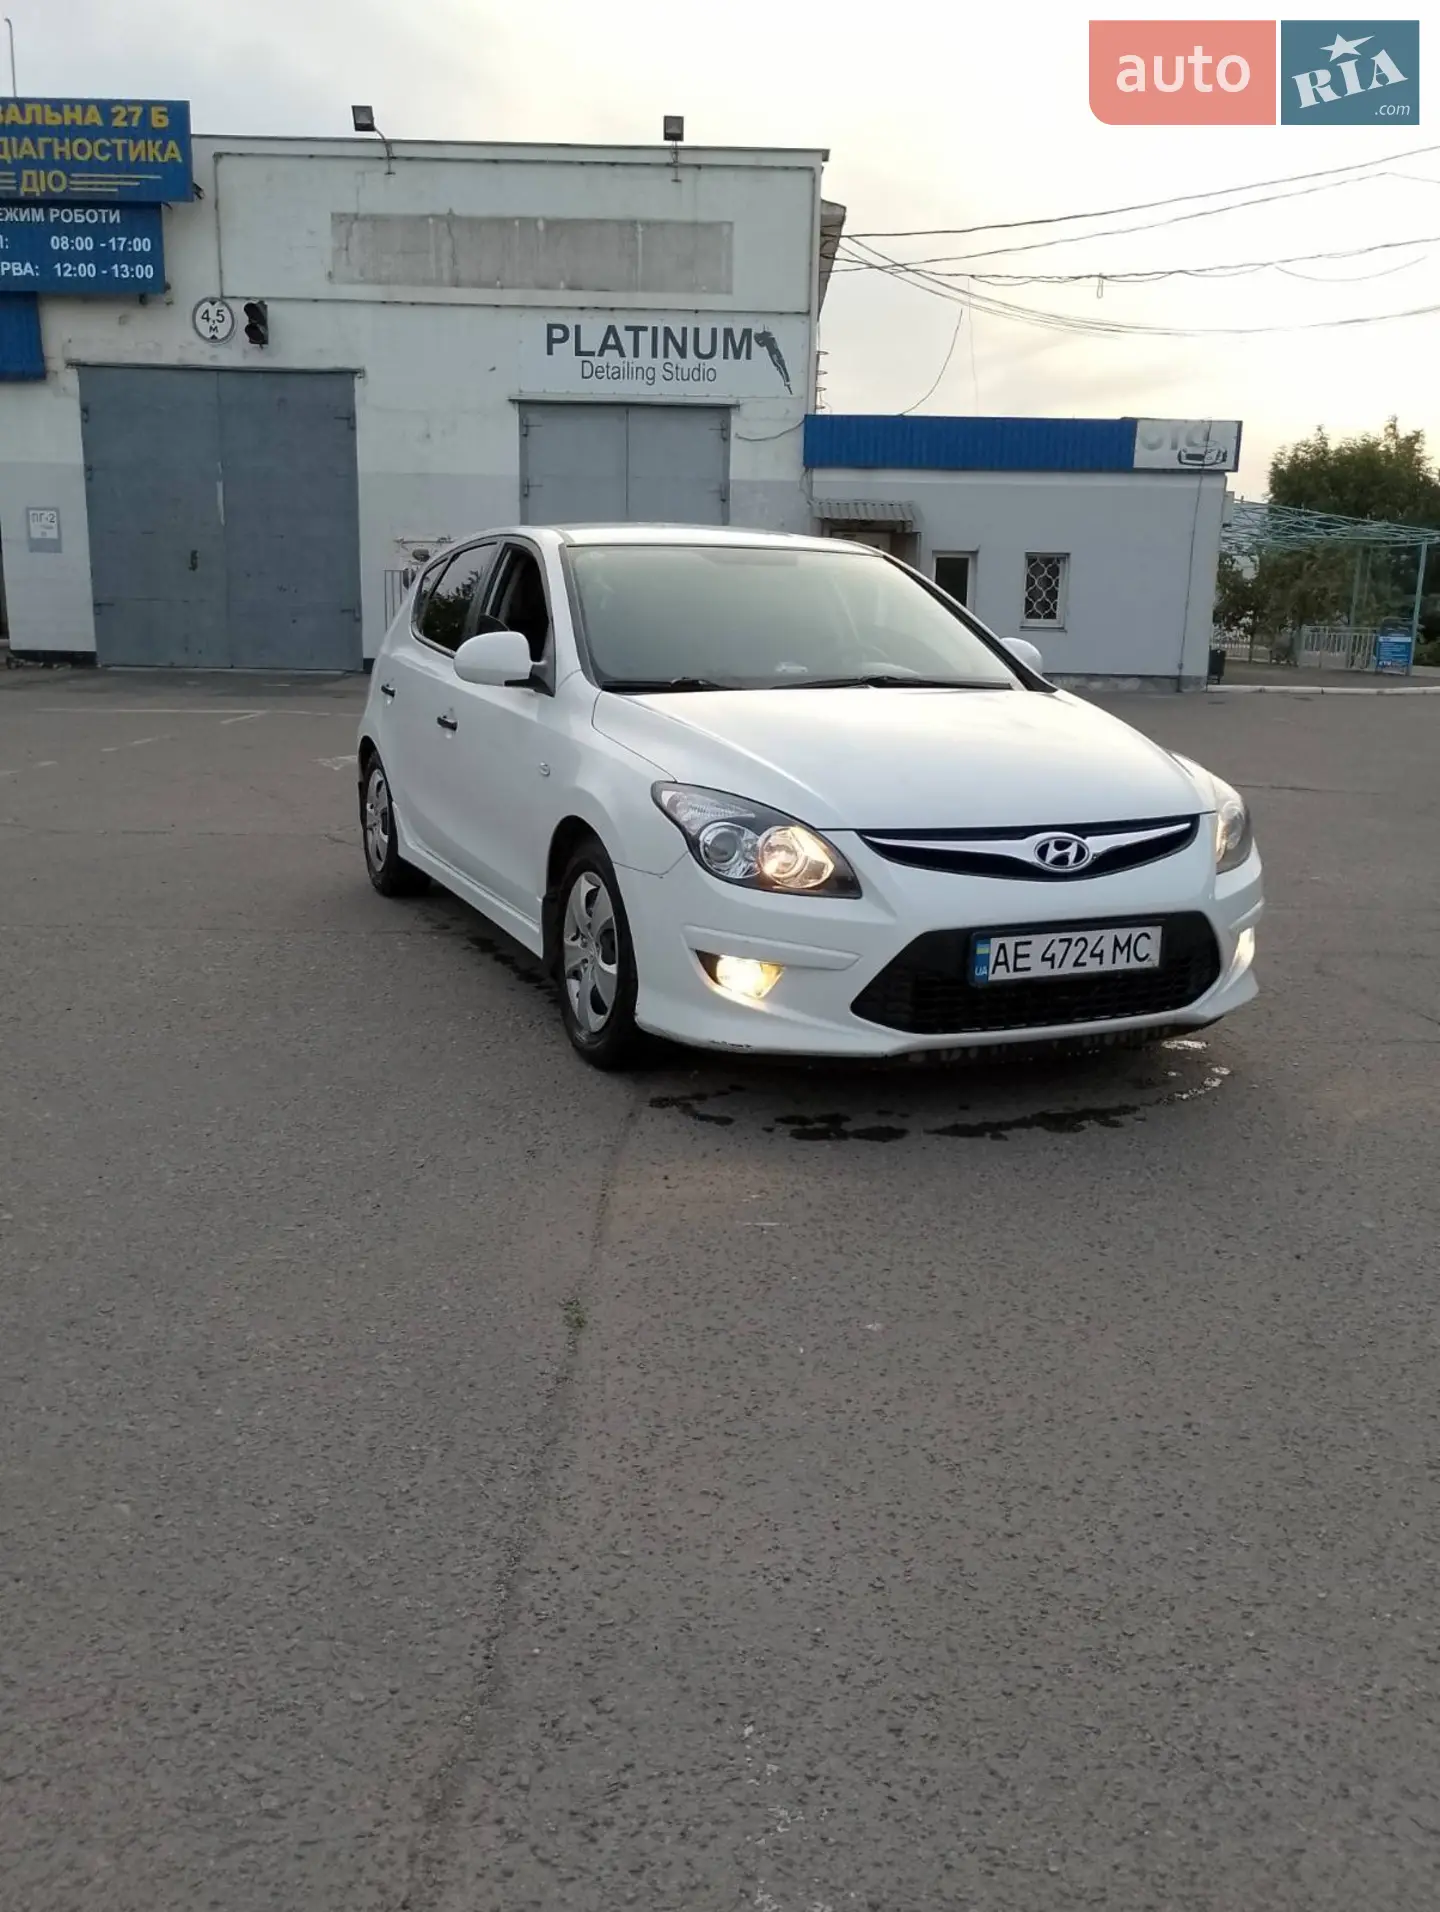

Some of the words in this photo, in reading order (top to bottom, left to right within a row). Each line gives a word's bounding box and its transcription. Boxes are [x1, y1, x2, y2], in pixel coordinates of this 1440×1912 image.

[0, 104, 104, 127] АЛЬНА
[111, 106, 140, 128] 27
[151, 106, 170, 129] Б
[20, 169, 68, 197] ДІО
[50, 208, 121, 225] РОБОТИ
[50, 235, 94, 252] 08:00
[109, 237, 151, 253] 17:00
[54, 262, 97, 279] 12:00
[114, 263, 154, 280] 13:00
[201, 309, 225, 325] 4,5
[546, 323, 752, 361] PLATINUM
[581, 360, 656, 386] Detailing
[662, 362, 717, 382] Studio
[990, 940, 1033, 975] AE
[1040, 935, 1104, 970] 4724
[1111, 932, 1152, 965] MC
